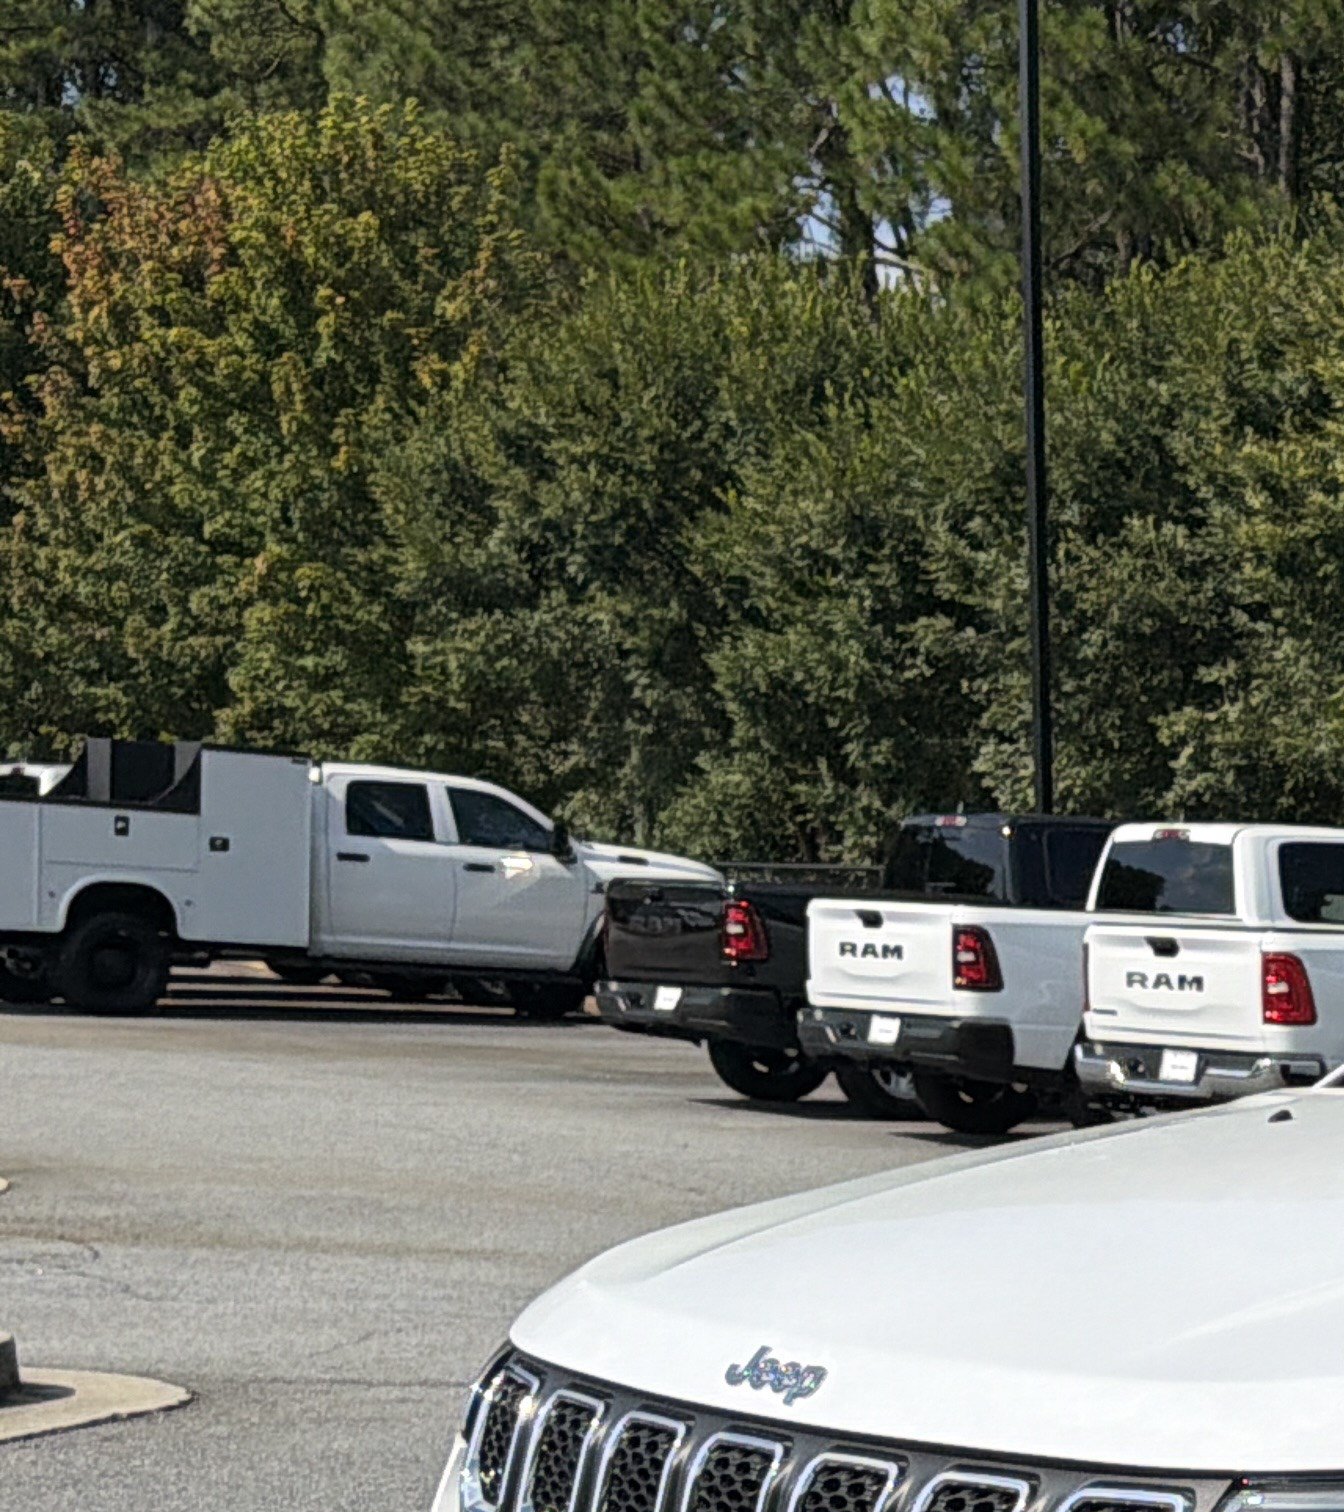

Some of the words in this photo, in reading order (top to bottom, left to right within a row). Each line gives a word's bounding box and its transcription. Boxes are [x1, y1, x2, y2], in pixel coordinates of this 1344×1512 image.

[839, 941, 904, 961] RAM
[1126, 971, 1204, 993] RAM
[724, 1344, 828, 1406] Jeep
